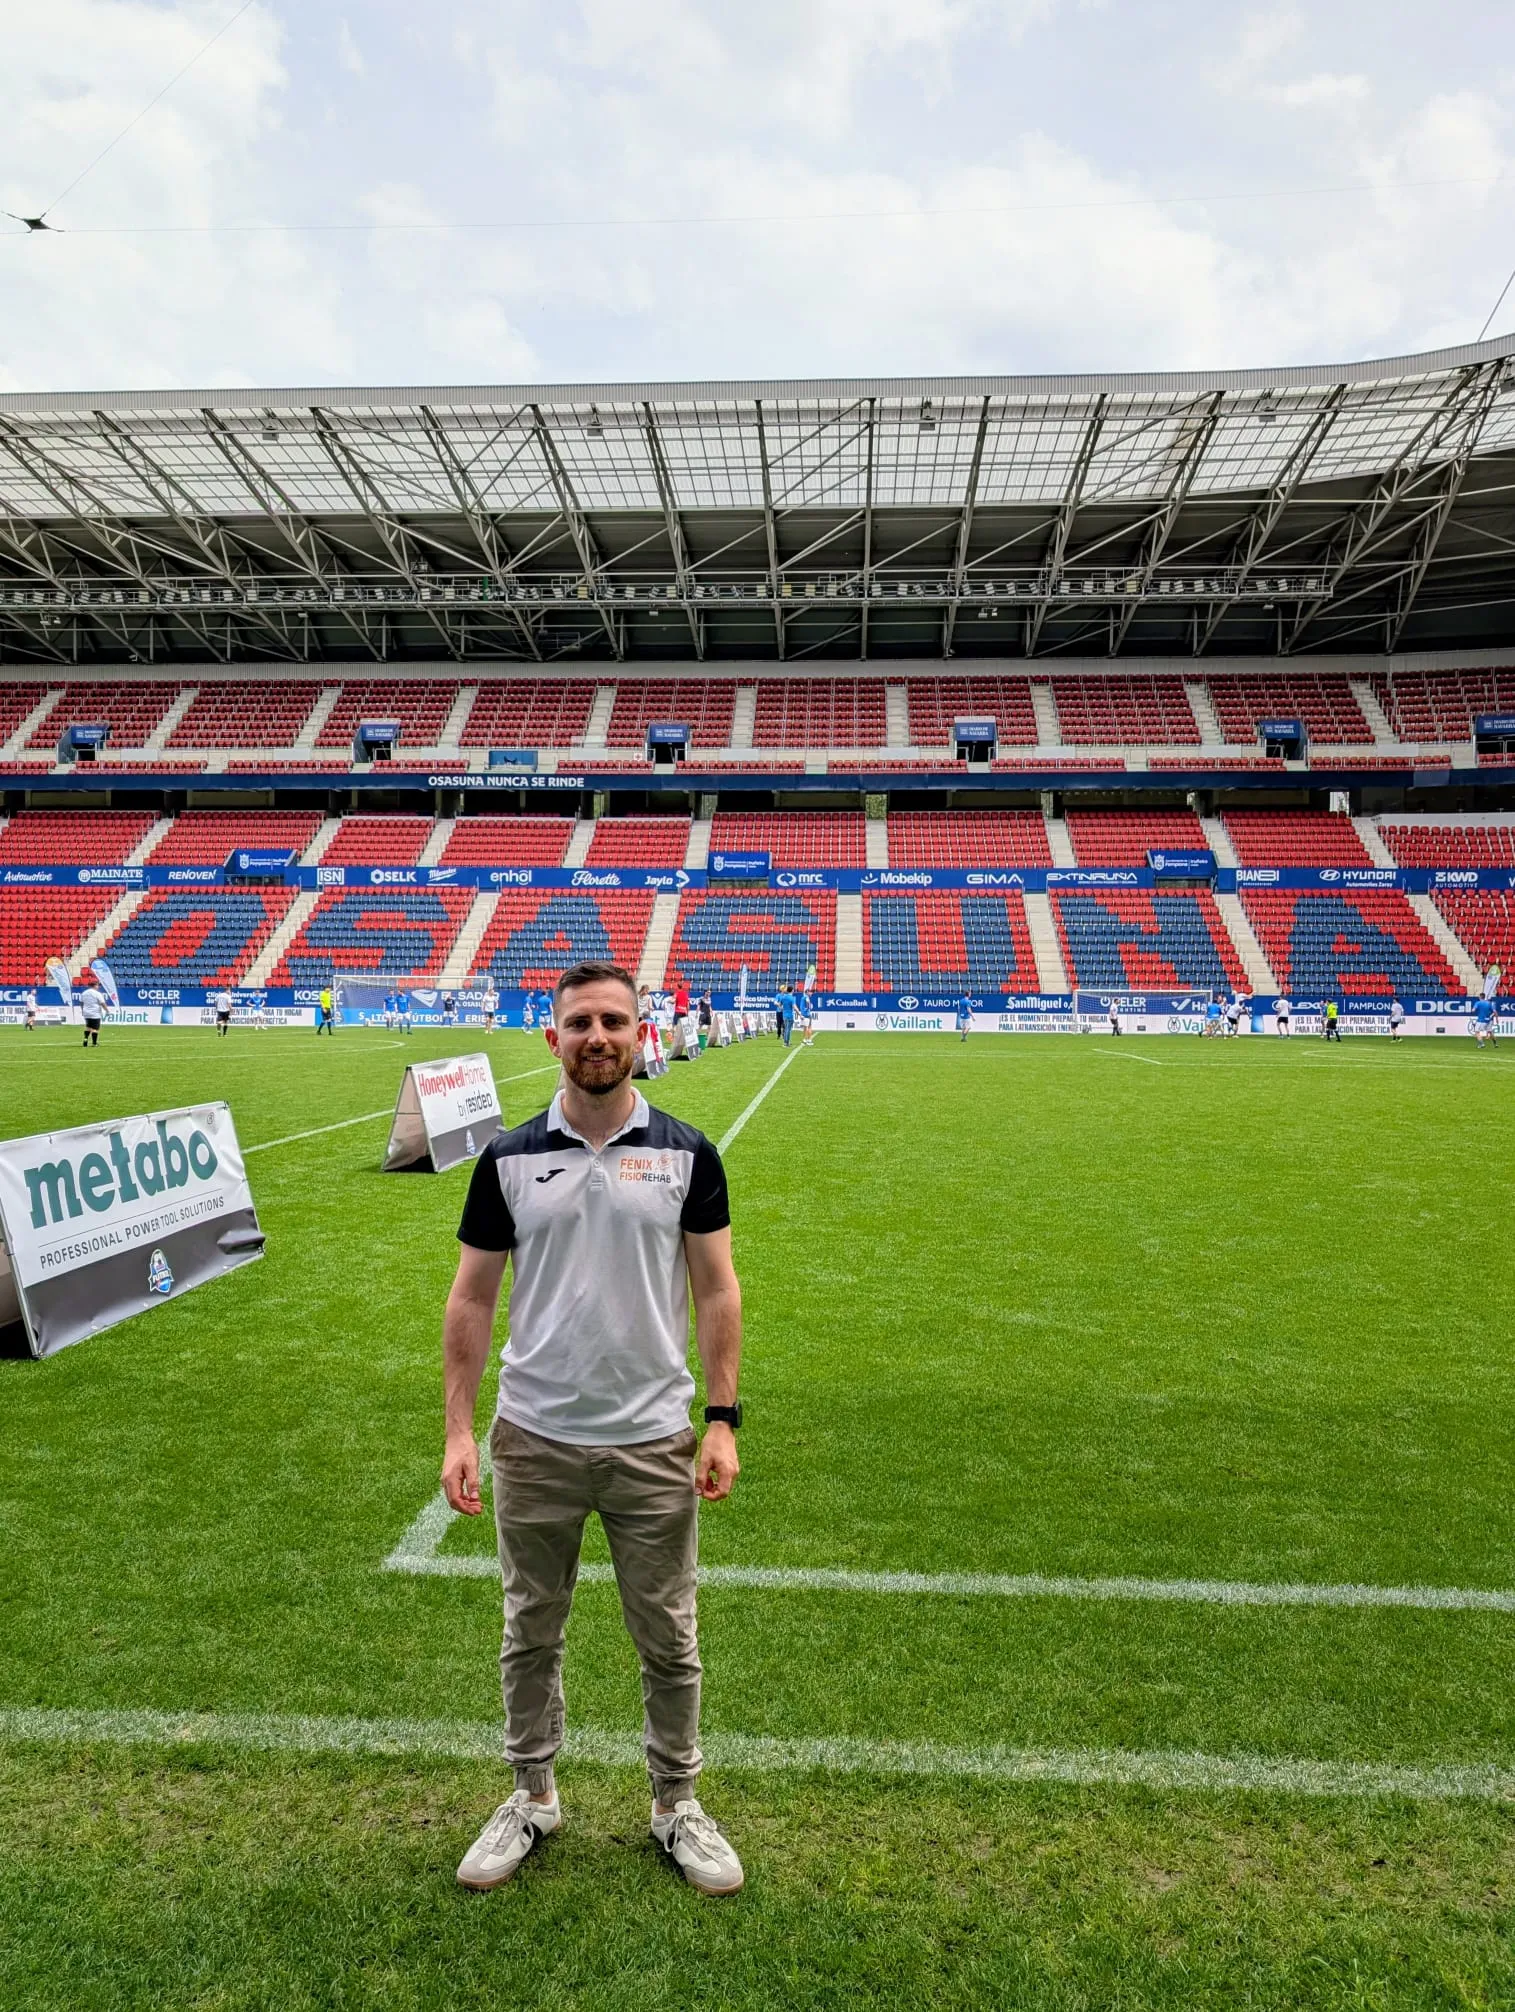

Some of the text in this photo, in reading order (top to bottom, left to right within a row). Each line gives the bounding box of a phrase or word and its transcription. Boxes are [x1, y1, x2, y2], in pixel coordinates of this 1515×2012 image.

[428, 775, 584, 788] OSASUNA NUNCA SE RINDE
[4, 870, 53, 882] Automotive
[91, 869, 143, 878] MAINATE
[319, 871, 342, 882] ISN
[384, 871, 417, 882] SELK
[571, 870, 621, 886] Florette
[798, 873, 824, 883] mrc
[880, 872, 932, 886] Mobekip
[966, 873, 1023, 884] GIMA
[1343, 871, 1396, 880] HYUNDAI
[1447, 872, 1478, 882] KWD
[149, 989, 180, 1000] CELER
[1349, 1002, 1391, 1010] PAMPLON
[1416, 1000, 1472, 1013] DIGI
[890, 1015, 943, 1030] Vaillant
[1010, 1014, 1017, 1022] EL
[1350, 1016, 1375, 1025] PREPARA
[418, 1065, 465, 1097] Honeywell
[457, 1090, 493, 1120] by resideo
[23, 1120, 218, 1229] metabo
[619, 1172, 672, 1184] FISIOREHAB
[40, 1196, 225, 1270] PROFESSIONAL POWER TOOL SOLUTIONS
